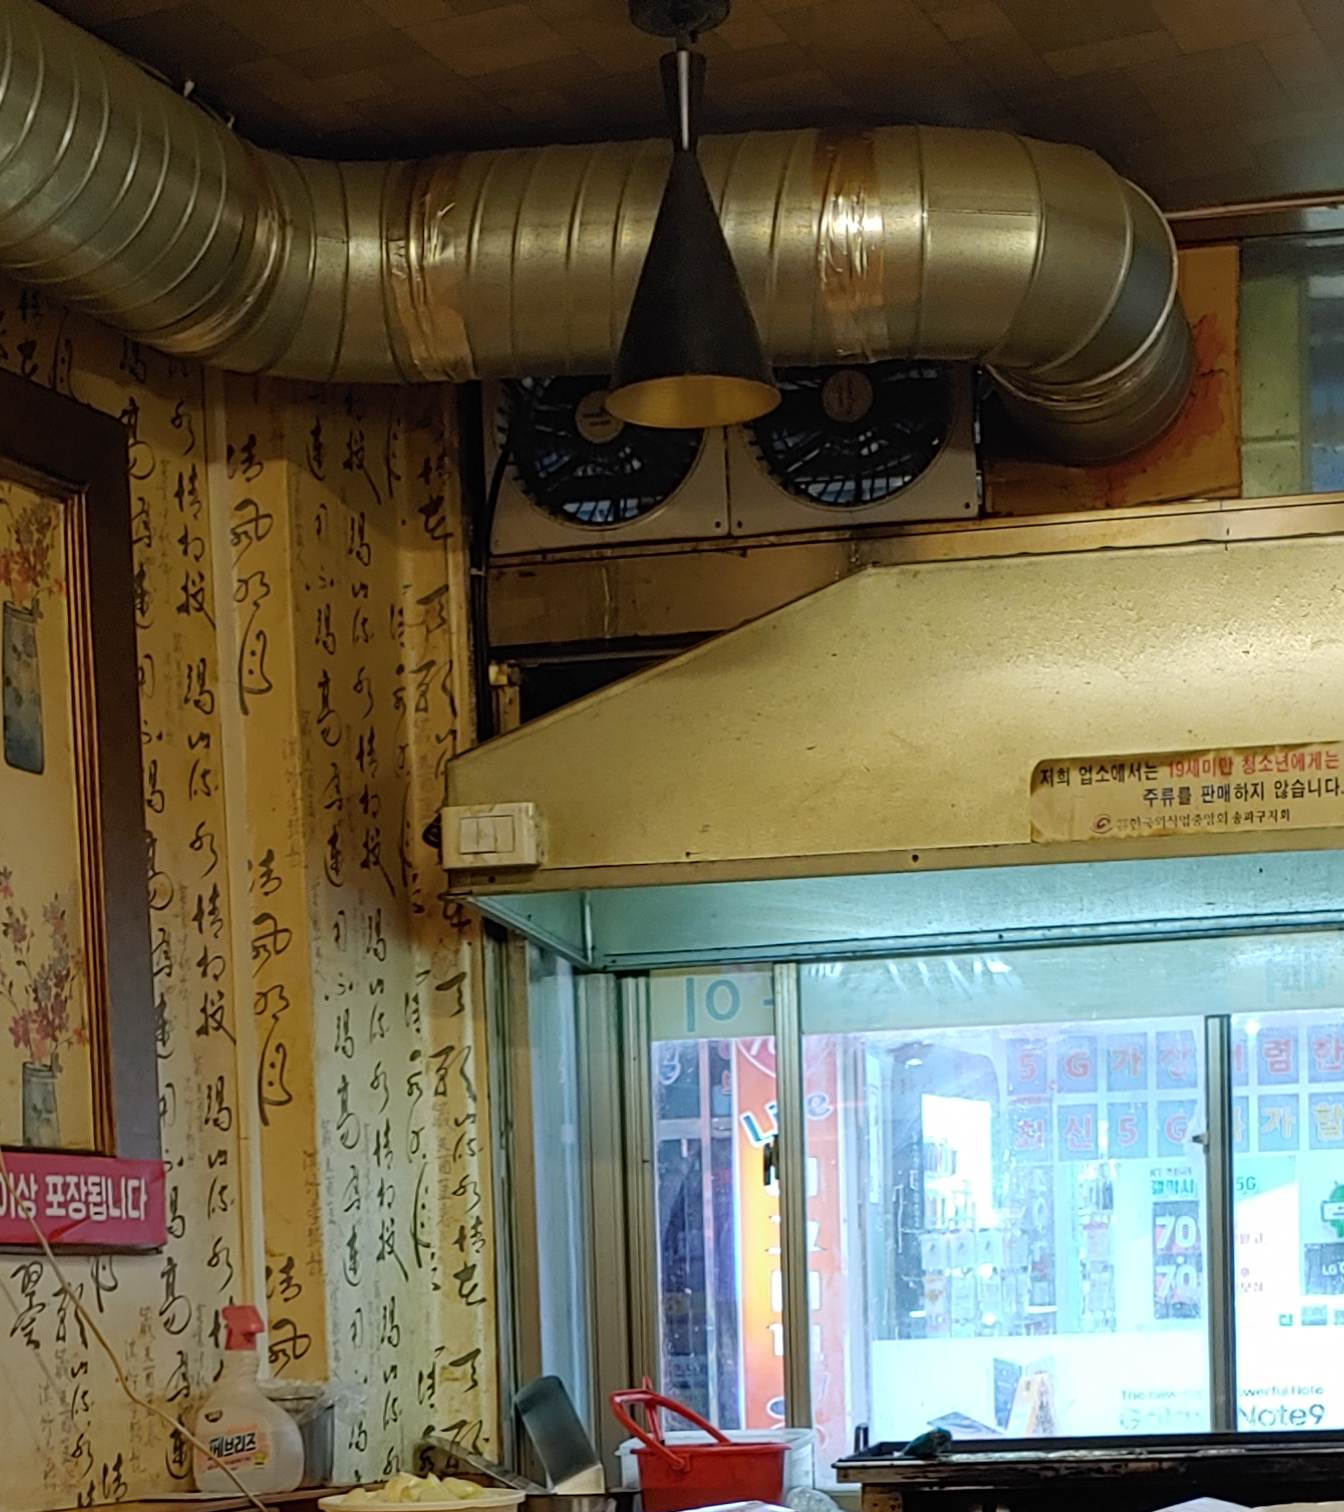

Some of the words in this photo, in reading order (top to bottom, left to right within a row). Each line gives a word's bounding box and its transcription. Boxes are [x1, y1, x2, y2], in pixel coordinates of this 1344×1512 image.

[1040, 767, 1071, 788] 저희
[1078, 763, 1159, 785] 업소에서는
[1167, 757, 1234, 779] 19세미만
[1241, 750, 1341, 775] 청소년에게는
[1143, 786, 1192, 807] 주류를
[1201, 782, 1266, 803] 판매하지
[1274, 777, 1344, 800] 않습니다.
[45, 1173, 147, 1221] 포장됩니다
[1155, 1215, 1197, 1248] 70
[209, 1432, 256, 1458] 페브리즈
